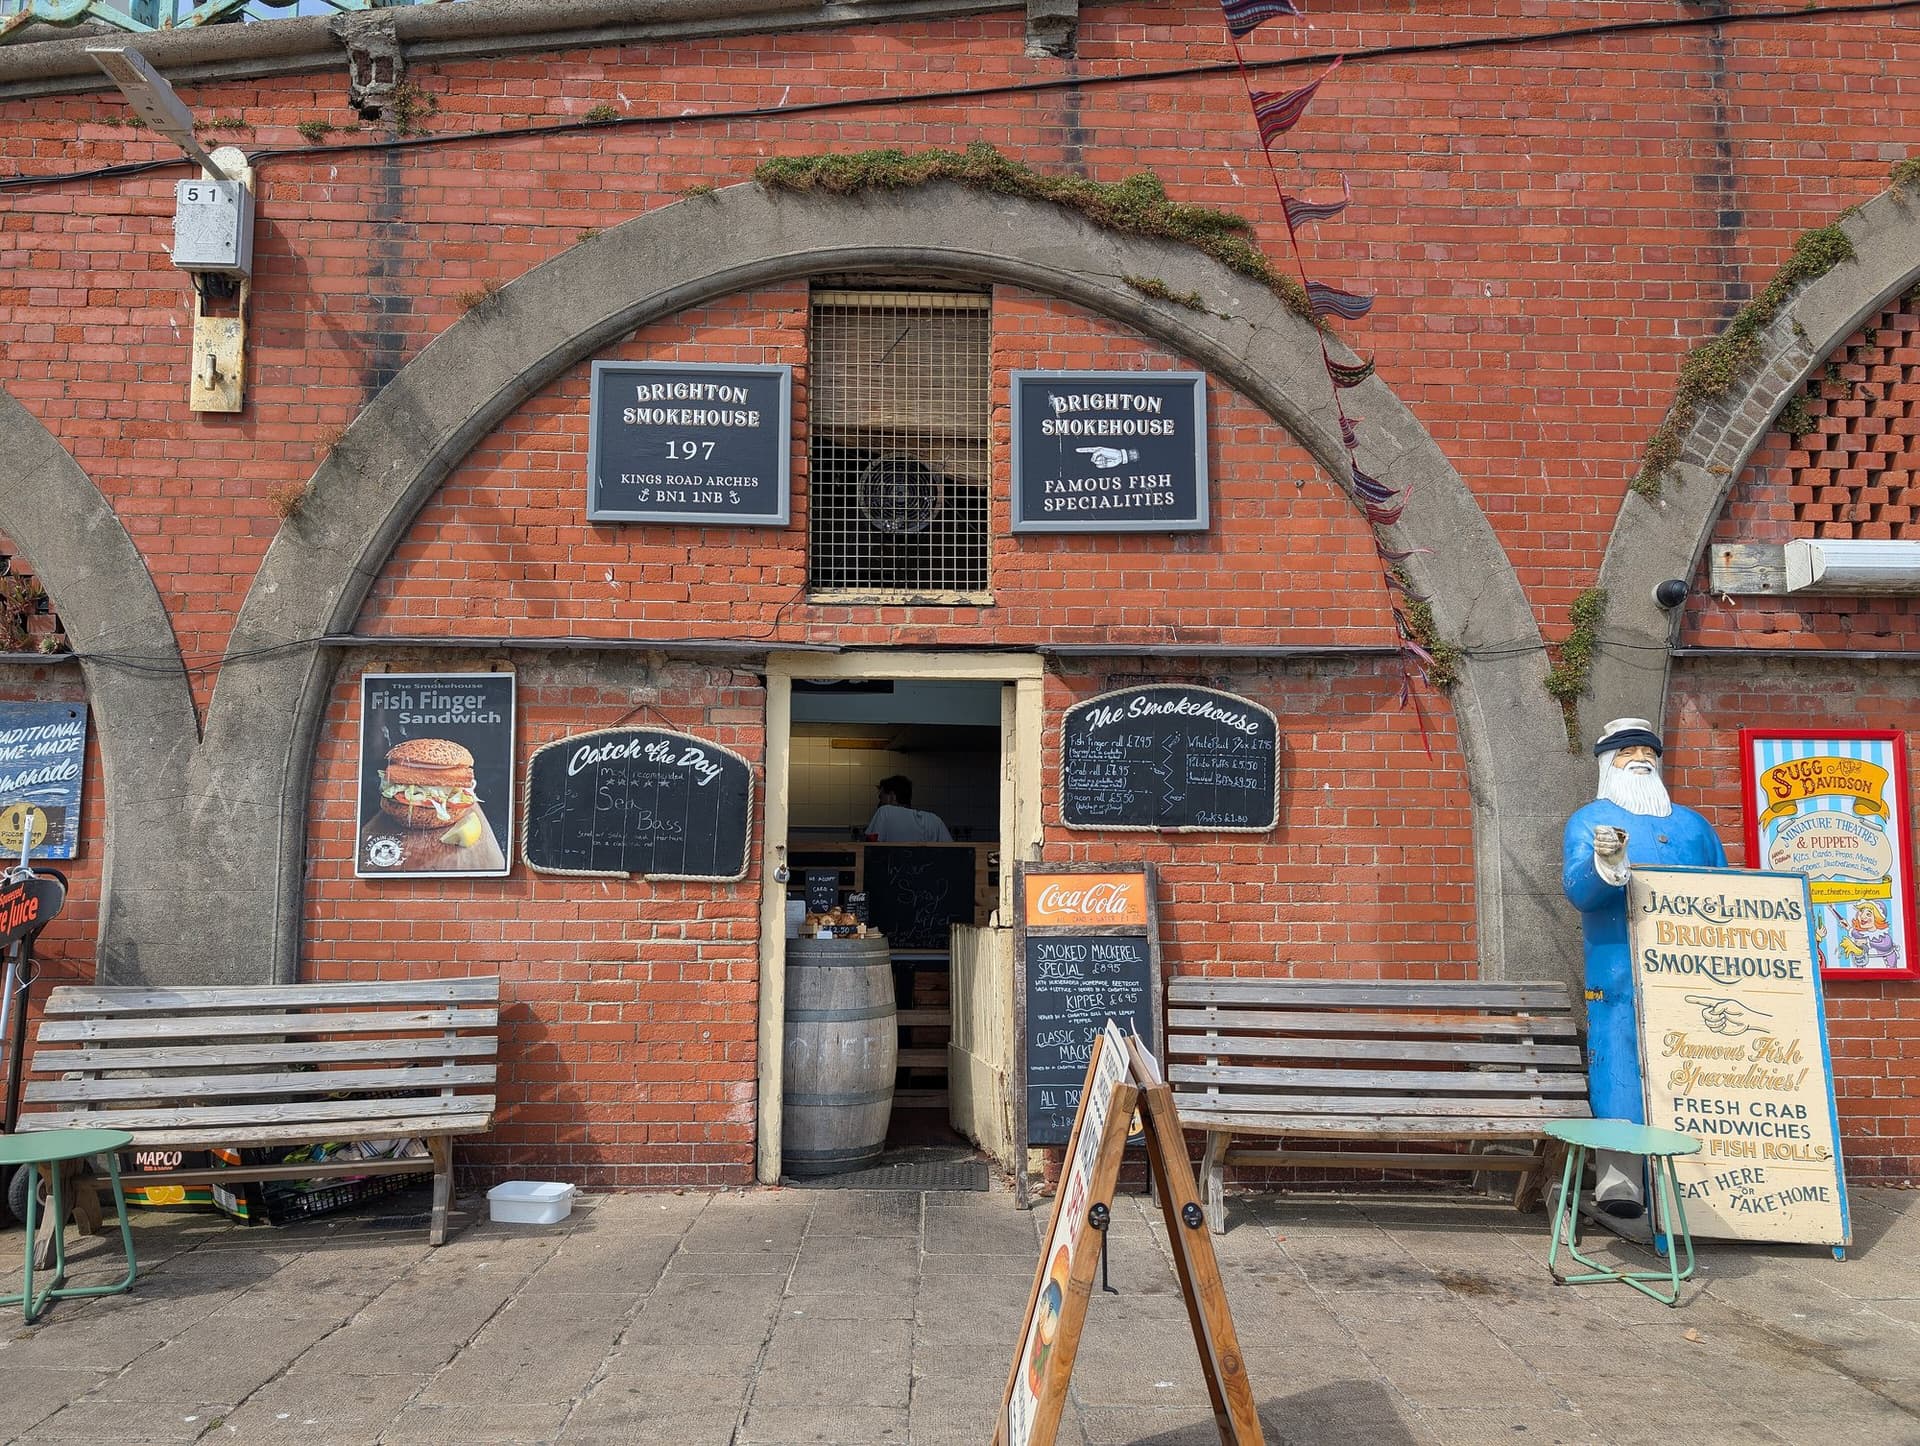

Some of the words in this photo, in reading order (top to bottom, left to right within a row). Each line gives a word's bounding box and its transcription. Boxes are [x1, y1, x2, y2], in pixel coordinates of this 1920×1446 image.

[636, 382, 749, 405] BRIGHTON
[1054, 393, 1163, 414] BRIGHTON
[622, 407, 761, 428] SMOKEHOUSE
[1041, 418, 1175, 436] SMOKEHOUSE
[665, 440, 716, 461] 197
[620, 474, 662, 485] KINGS
[666, 475, 703, 486] ROAD
[706, 476, 759, 488] ARCHES
[1044, 476, 1122, 494] FAMOUS
[1128, 474, 1172, 490] FISH
[656, 490, 686, 503] BN1
[692, 492, 723, 504] 1NB
[1044, 492, 1175, 512] SPECIALITIES
[371, 691, 414, 710] Fish
[420, 691, 486, 714] Finger
[399, 711, 501, 724] Sandwich
[1085, 706, 1124, 732] The
[1127, 696, 1259, 735] Smokehouse
[644, 740, 670, 754] of
[1086, 732, 1110, 752] Finger
[568, 738, 642, 776] Catch
[648, 749, 676, 764] the
[676, 748, 724, 786] Day
[1069, 760, 1086, 776] Crab
[1772, 759, 1823, 798] SUGG
[1800, 776, 1873, 796] DAVIDSON
[596, 786, 642, 811] Sea
[637, 810, 682, 833] Bass
[1781, 817, 1833, 848] MINIATURE
[1836, 818, 1879, 847] THEATRES
[1796, 836, 1808, 848] &
[1811, 836, 1859, 849] PUPPETS
[1643, 890, 1707, 919] JACK
[1702, 895, 1718, 912] &
[1718, 894, 1802, 921] LINDA'S
[1656, 920, 1788, 951] BRIGHTON
[1037, 944, 1087, 960] SMOKED
[1092, 944, 1142, 960] MACKEREL
[1038, 962, 1085, 978] SPECIAL
[1644, 948, 1804, 984] SMOKEHOUSE
[1066, 994, 1104, 1009] KIPPER
[1036, 1030, 1074, 1046] CLASSIC
[1662, 1031, 1746, 1058] Famous
[1748, 1036, 1803, 1065] Fish
[1060, 1045, 1093, 1060] MACKE
[1667, 1060, 1810, 1095] Specialities!
[1040, 1090, 1058, 1106] ALL
[1673, 1098, 1740, 1116] FRESH
[1750, 1102, 1808, 1120] CRAB
[1674, 1116, 1811, 1140] SANDWICHES
[136, 1150, 182, 1167] MAPCO
[1710, 1138, 1758, 1158] FISH
[1762, 1142, 1828, 1162] ROLLS
[1678, 1179, 1712, 1200] EAT
[1715, 1168, 1765, 1191] HERE
[1741, 1186, 1754, 1196] OR
[1729, 1194, 1778, 1214] TAKE
[1779, 1186, 1830, 1207] HOME
